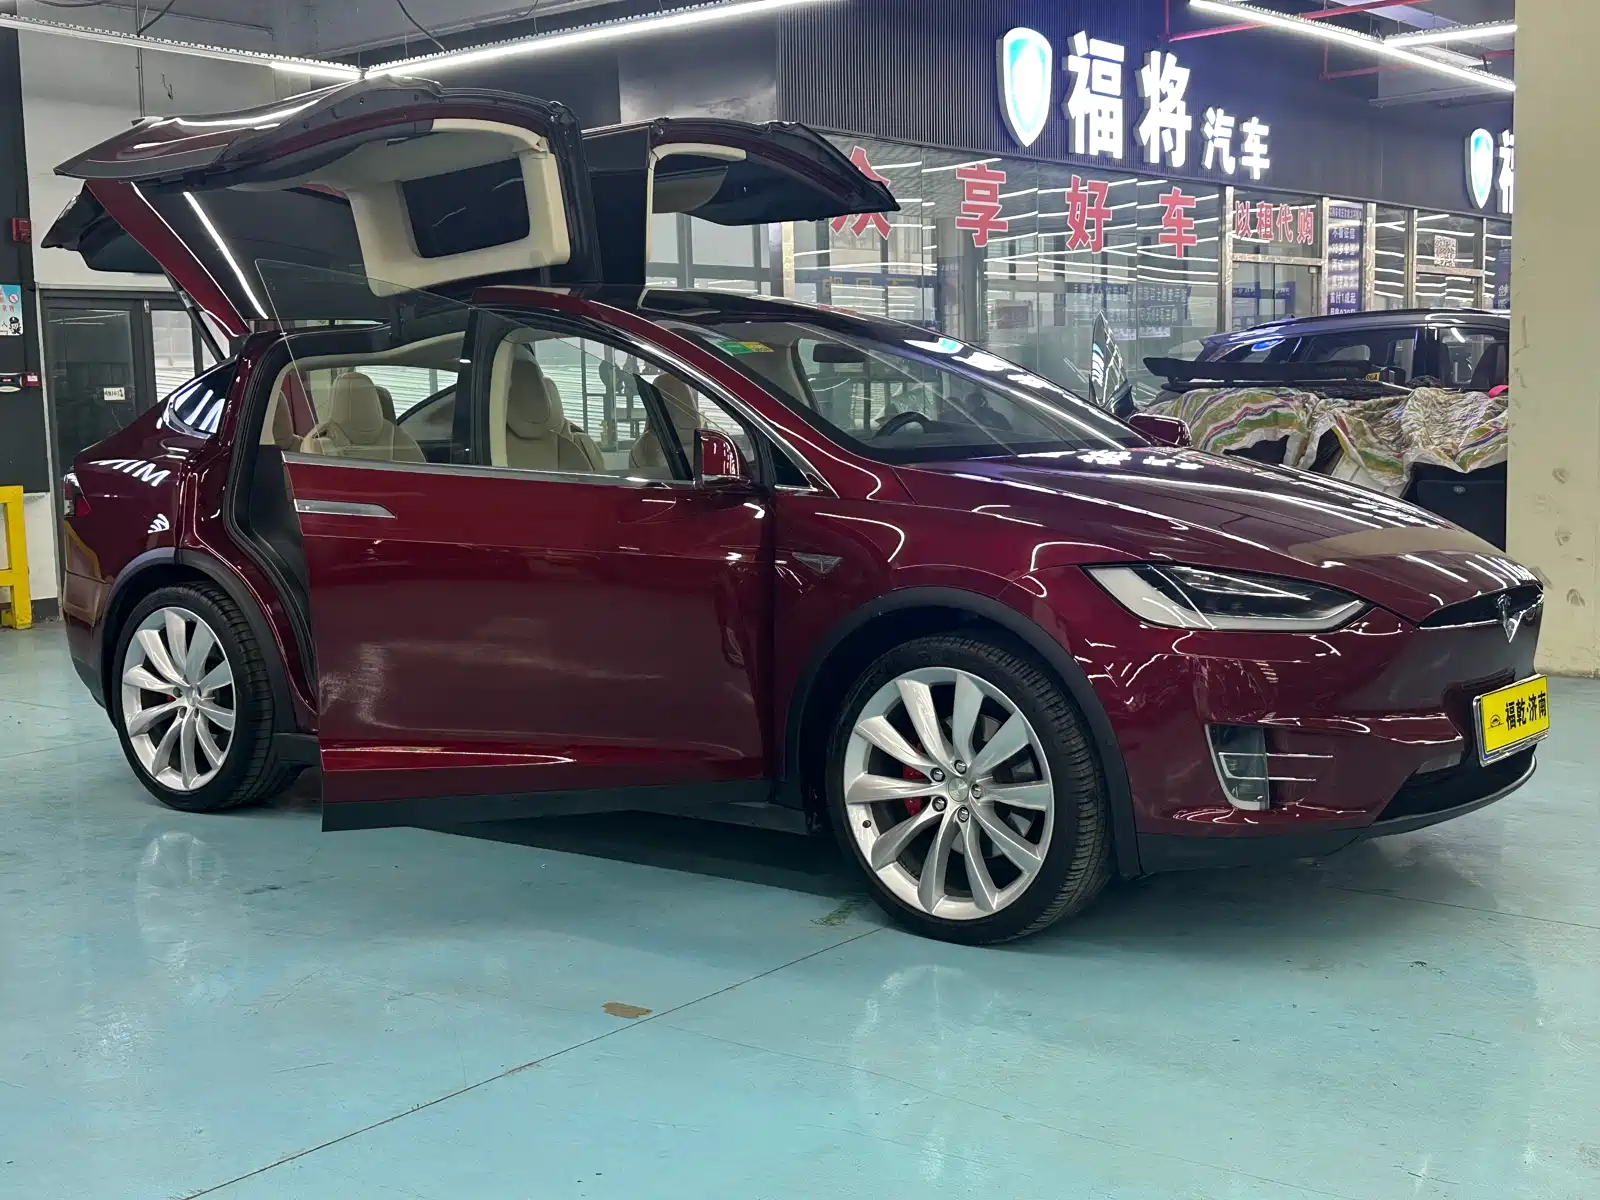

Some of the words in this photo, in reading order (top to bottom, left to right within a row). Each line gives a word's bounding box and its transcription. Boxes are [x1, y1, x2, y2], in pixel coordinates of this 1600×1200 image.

[1063, 30, 1270, 180] 福将汽车
[1235, 200, 1314, 245] 以租代购
